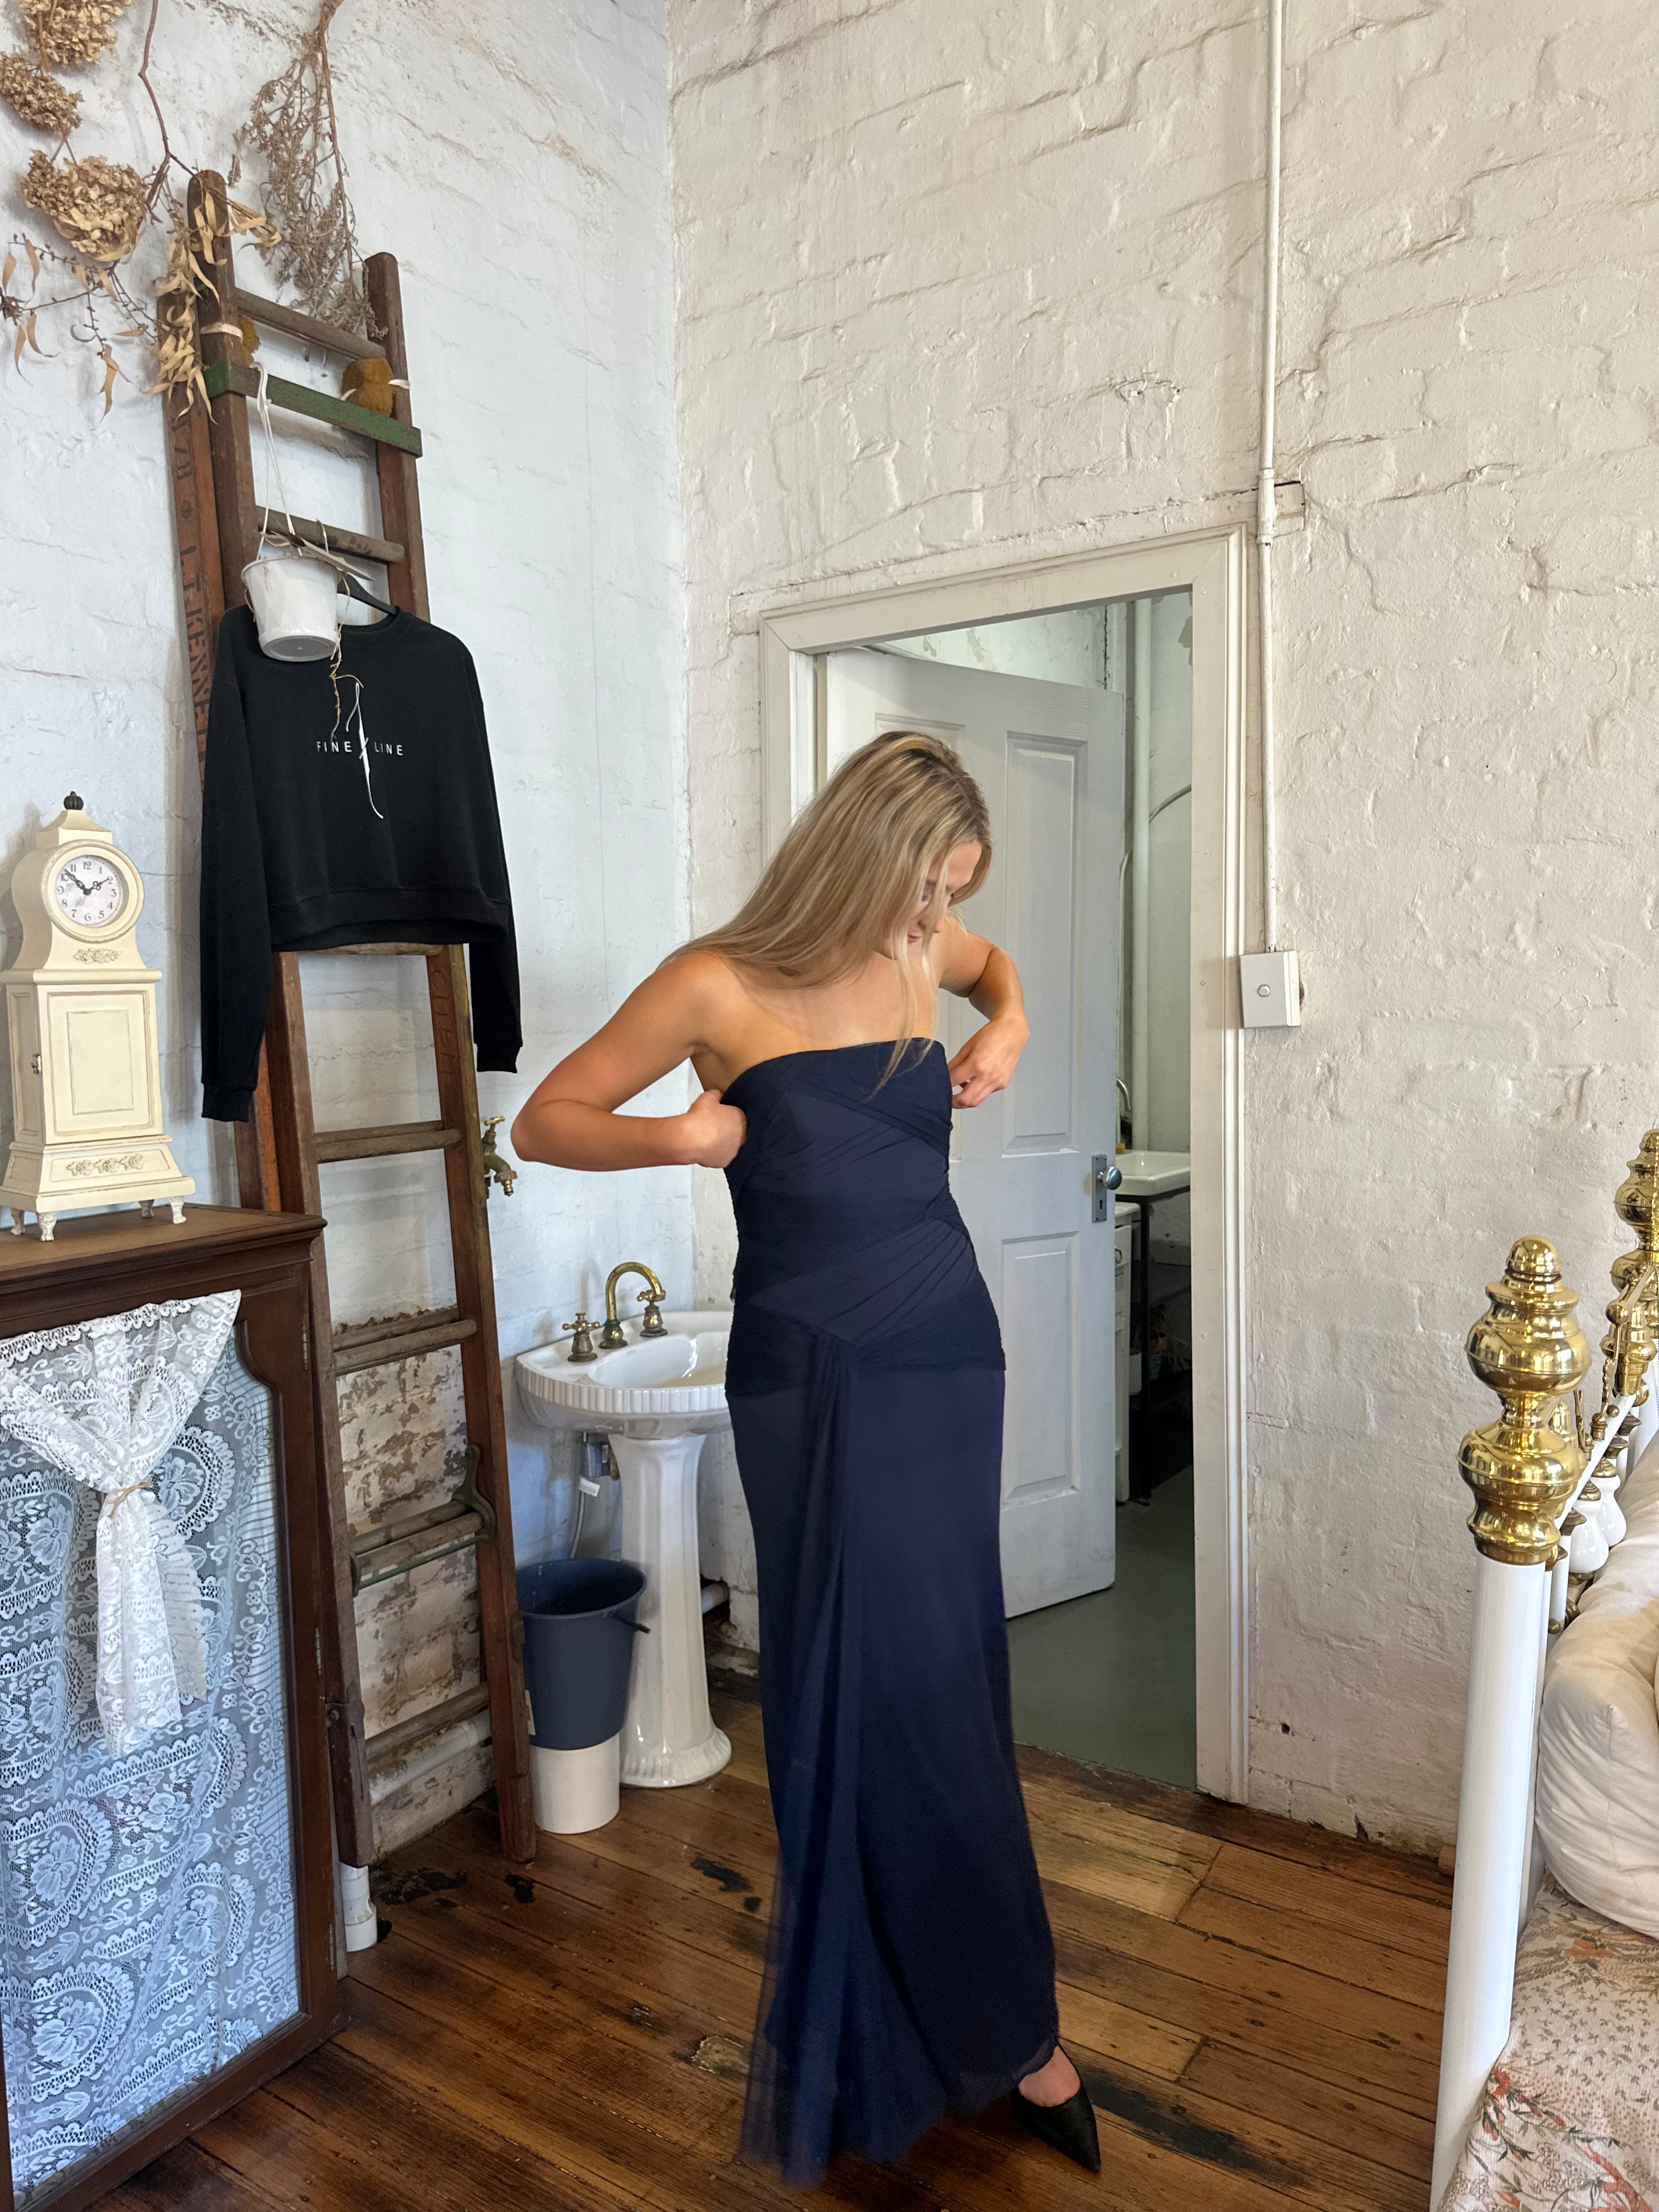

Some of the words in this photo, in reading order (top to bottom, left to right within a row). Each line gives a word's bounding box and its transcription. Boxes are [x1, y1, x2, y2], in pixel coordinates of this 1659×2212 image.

[317, 741, 352, 753] FINE
[375, 741, 403, 756] LINE
[83, 861, 91, 870] 12
[61, 873, 69, 882] 10
[57, 886, 64, 894] 9
[61, 899, 67, 907] 8
[72, 909, 77, 917] 7
[99, 911, 104, 919] 5
[84, 913, 91, 922] 6
